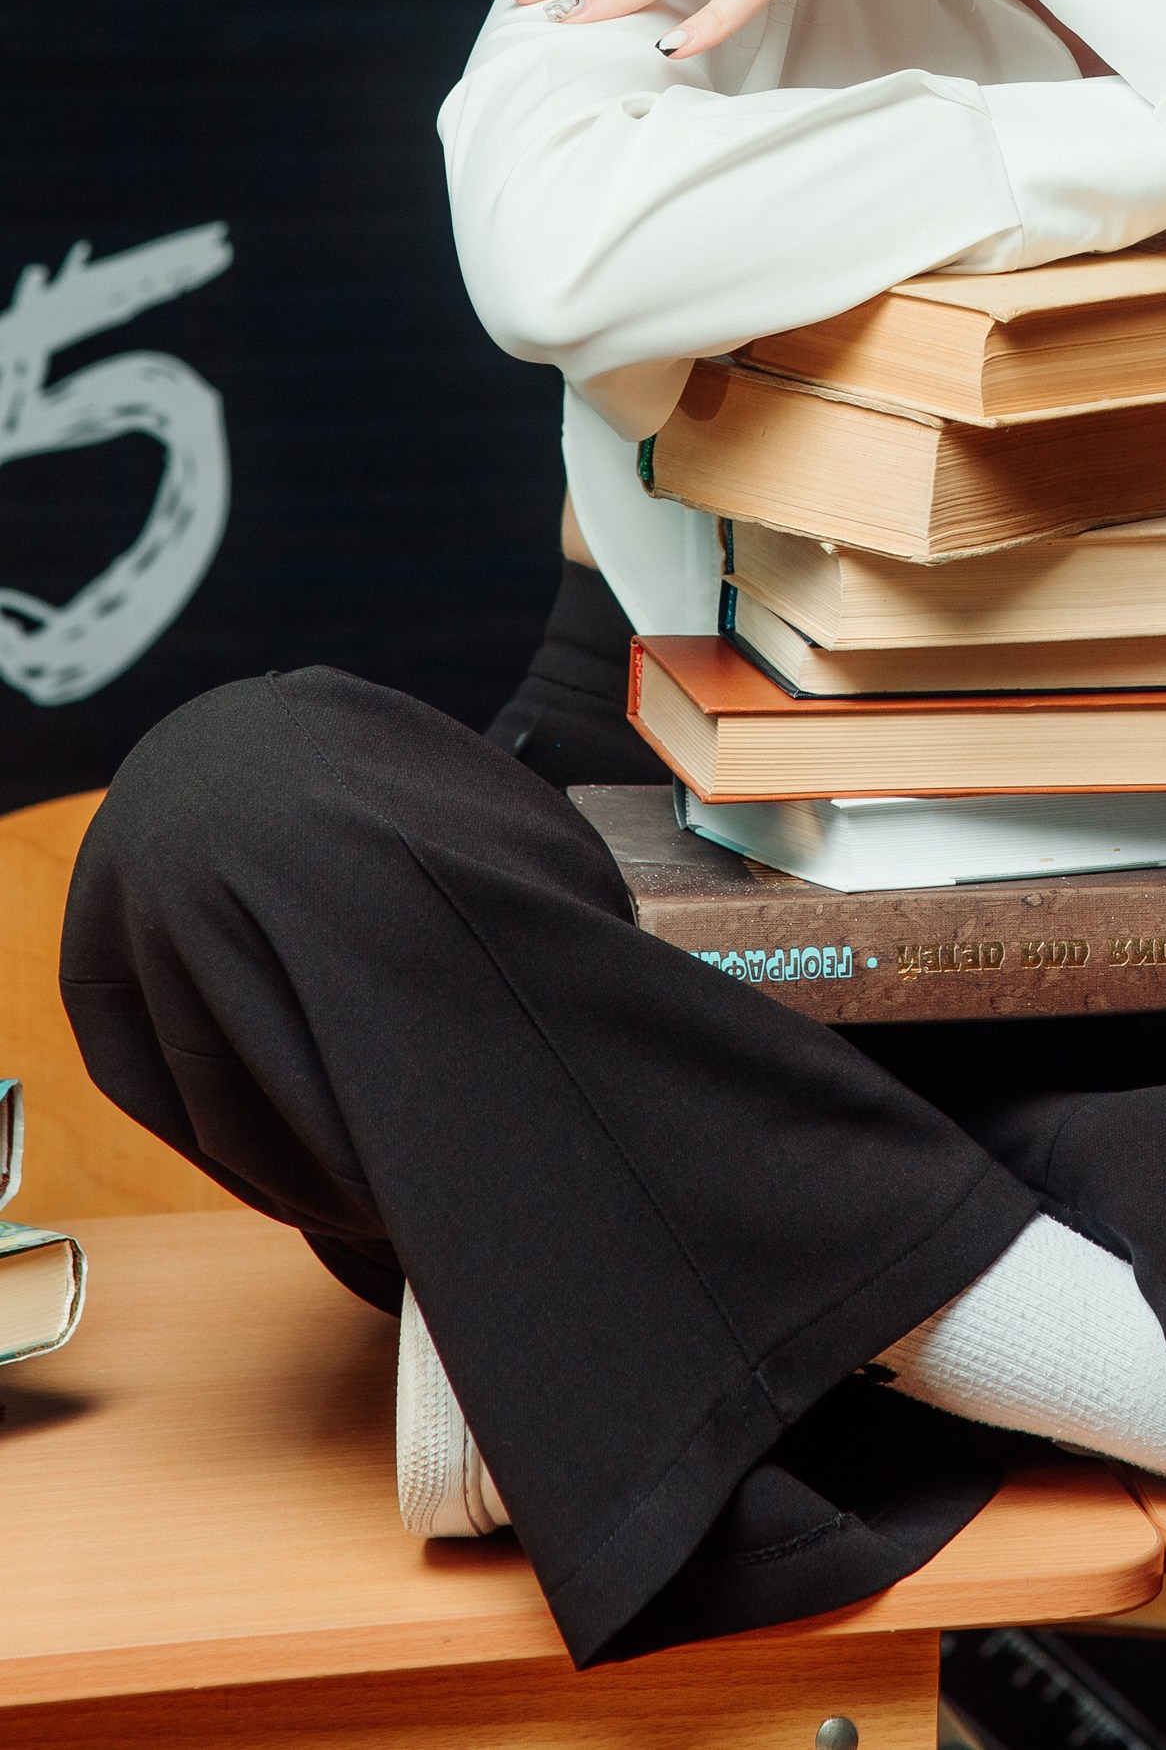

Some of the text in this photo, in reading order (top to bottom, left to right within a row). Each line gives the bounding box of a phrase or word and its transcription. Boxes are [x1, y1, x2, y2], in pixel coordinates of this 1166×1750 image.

[689, 945, 854, 983] ГЕОГРАФ
[896, 941, 1006, 981] ДЕТЕЙ
[1020, 940, 1091, 970] ДЛЯ
